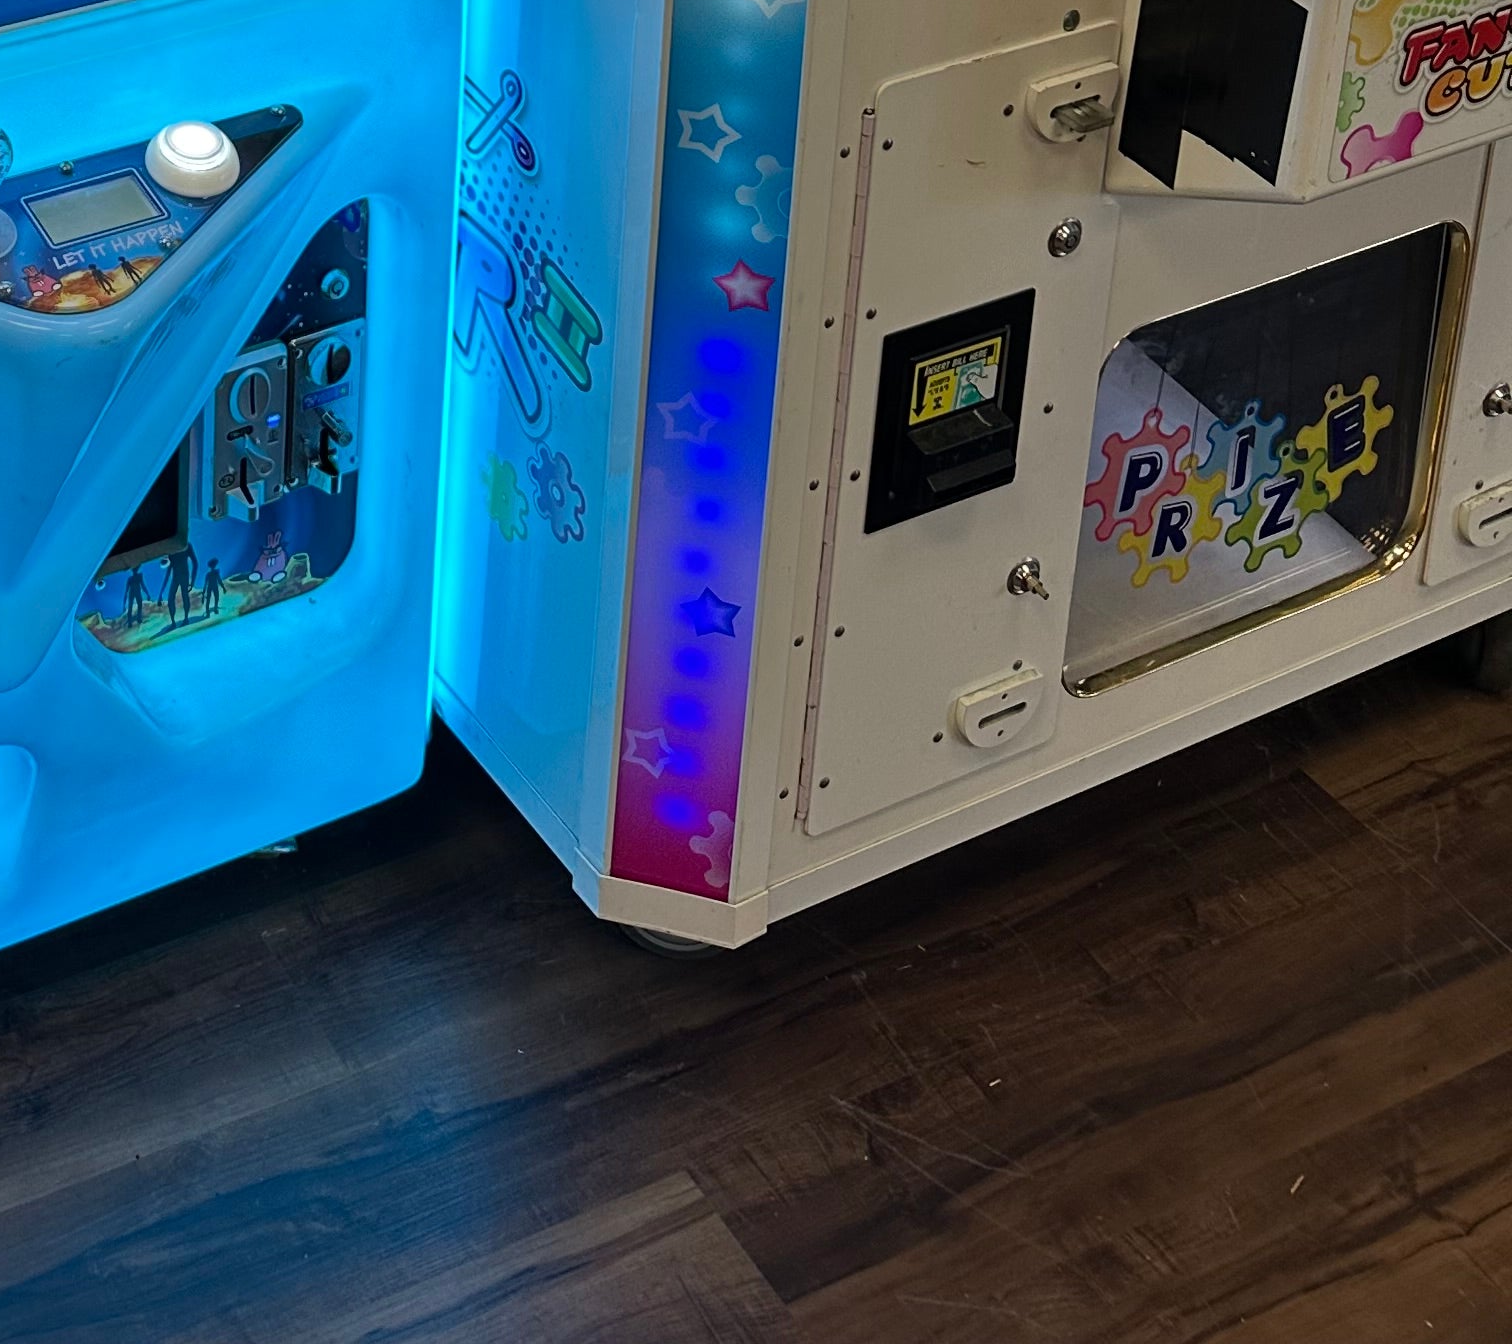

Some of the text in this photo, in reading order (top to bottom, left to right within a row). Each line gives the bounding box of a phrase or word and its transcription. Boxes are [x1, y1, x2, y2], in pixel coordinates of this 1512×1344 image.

[1425, 54, 1512, 117] CU
[52, 219, 185, 270] LET IT HAPPEN
